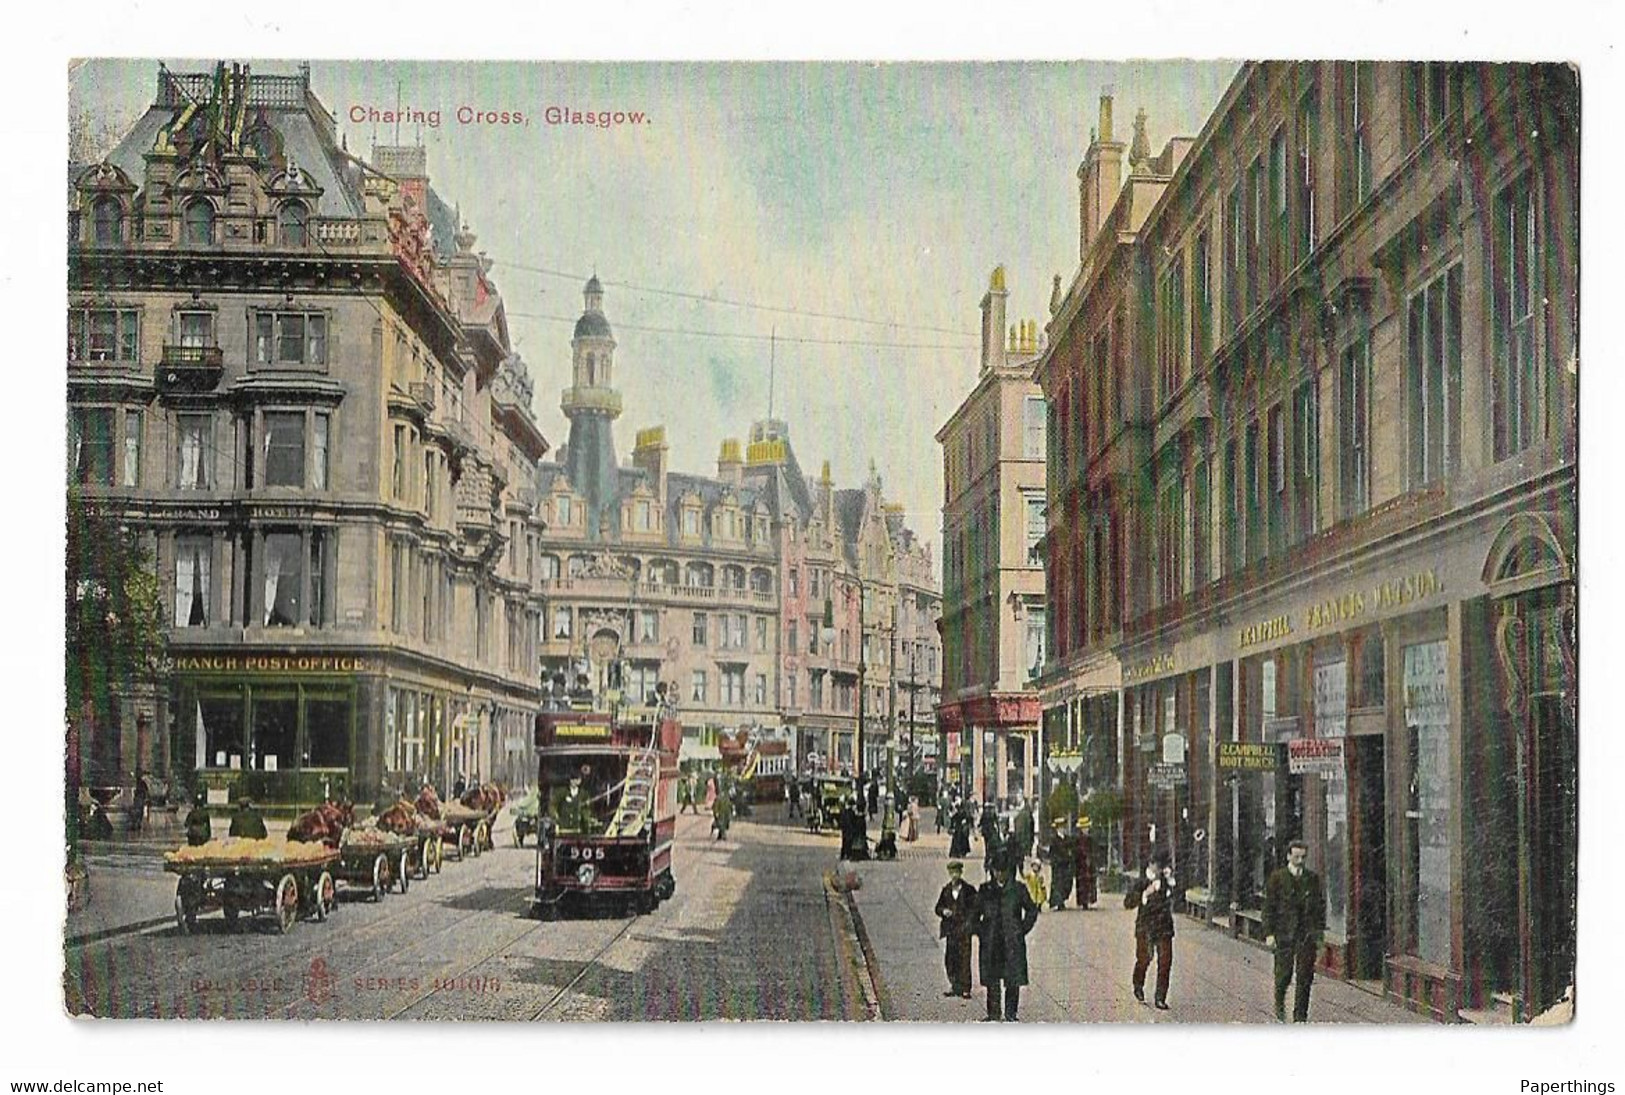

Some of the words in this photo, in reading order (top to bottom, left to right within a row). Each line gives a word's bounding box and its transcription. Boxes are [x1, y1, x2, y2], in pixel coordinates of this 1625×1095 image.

[161, 509, 220, 519] GRAND
[253, 507, 305, 518] HOTEL
[245, 656, 291, 671] POST
[298, 656, 366, 671] OFFICE
